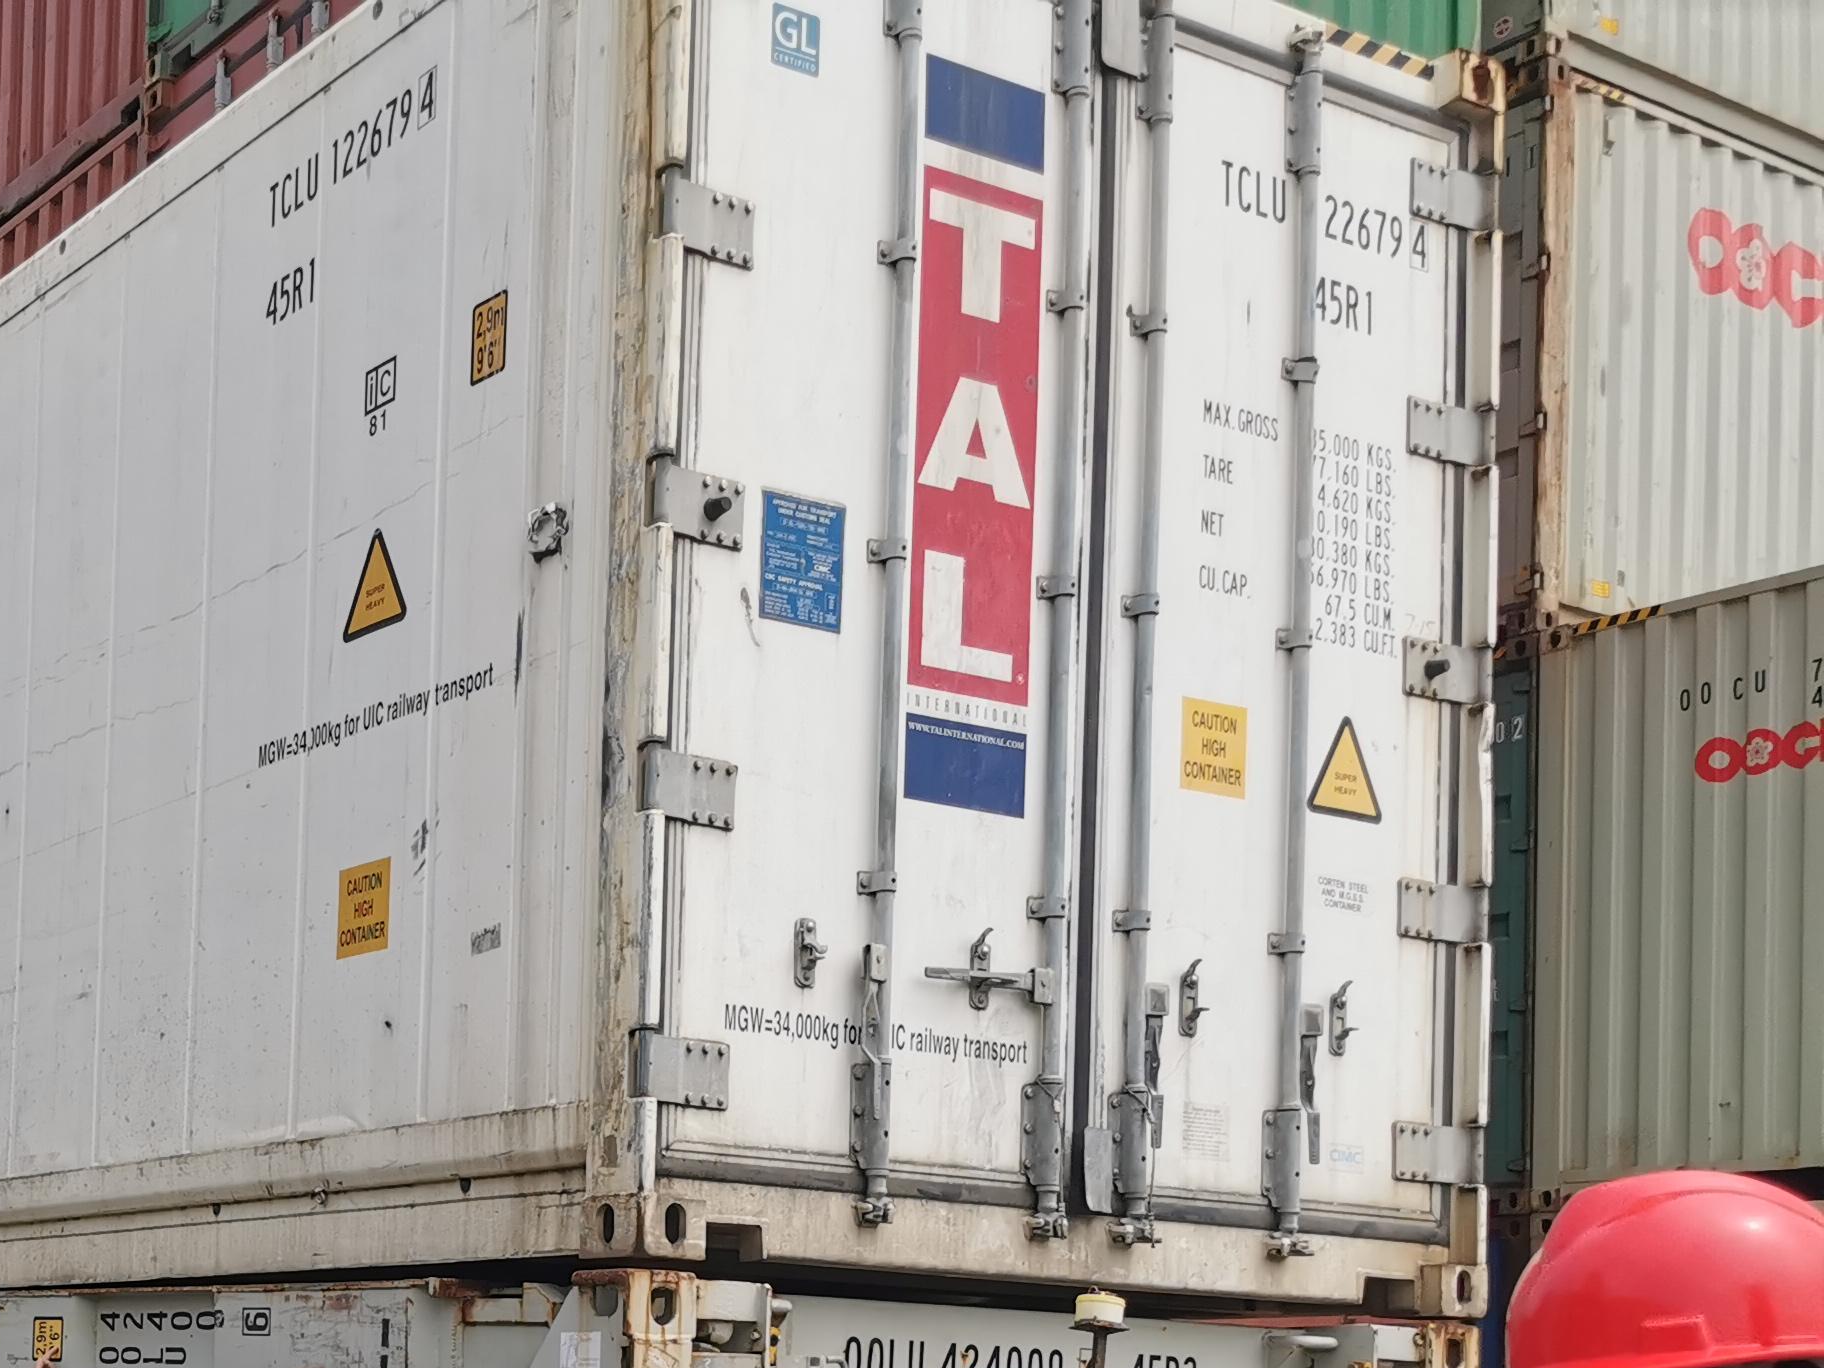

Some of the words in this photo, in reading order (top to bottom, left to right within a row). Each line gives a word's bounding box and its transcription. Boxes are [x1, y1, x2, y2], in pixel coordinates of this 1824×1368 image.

[775, 11, 816, 56] GL
[773, 52, 816, 72] CERTIFIED
[269, 152, 319, 228] TCLU
[333, 89, 412, 185] 122679
[420, 71, 434, 120] 4
[1221, 159, 1286, 223] TCLU
[1324, 194, 1402, 259] 22679
[1412, 224, 1426, 268] 4
[265, 257, 315, 325] 45R1
[1315, 276, 1372, 335] 45R1
[369, 409, 387, 436] 81
[918, 187, 1037, 683] TAL
[1203, 454, 1233, 485] TARE
[1201, 509, 1224, 537] NET
[344, 713, 361, 738] for
[363, 701, 384, 730] UIC
[387, 688, 430, 723] railway
[435, 662, 494, 706] tansport
[906, 692, 1027, 727] INTERNATIONAL
[908, 721, 1025, 750] WWW.TALINTERNATIONAL.COM
[1191, 710, 1237, 735] CAUTION
[1201, 737, 1226, 759] HIGH
[1184, 760, 1241, 786] CONTAINER
[1334, 771, 1358, 783] SUPER
[1334, 785, 1358, 796] HEAVY
[346, 871, 383, 897] CAUTION
[1318, 876, 1346, 889] CORTEN
[1348, 880, 1369, 894] STEEL
[353, 898, 374, 920] HIGH
[1323, 898, 1362, 912] CONTAINER
[339, 921, 386, 948] CONTAINER
[724, 1004, 840, 1050] MGW=34,000kg
[890, 1023, 906, 1050] IC
[909, 1027, 960, 1063] railway
[963, 1033, 1028, 1068] transport
